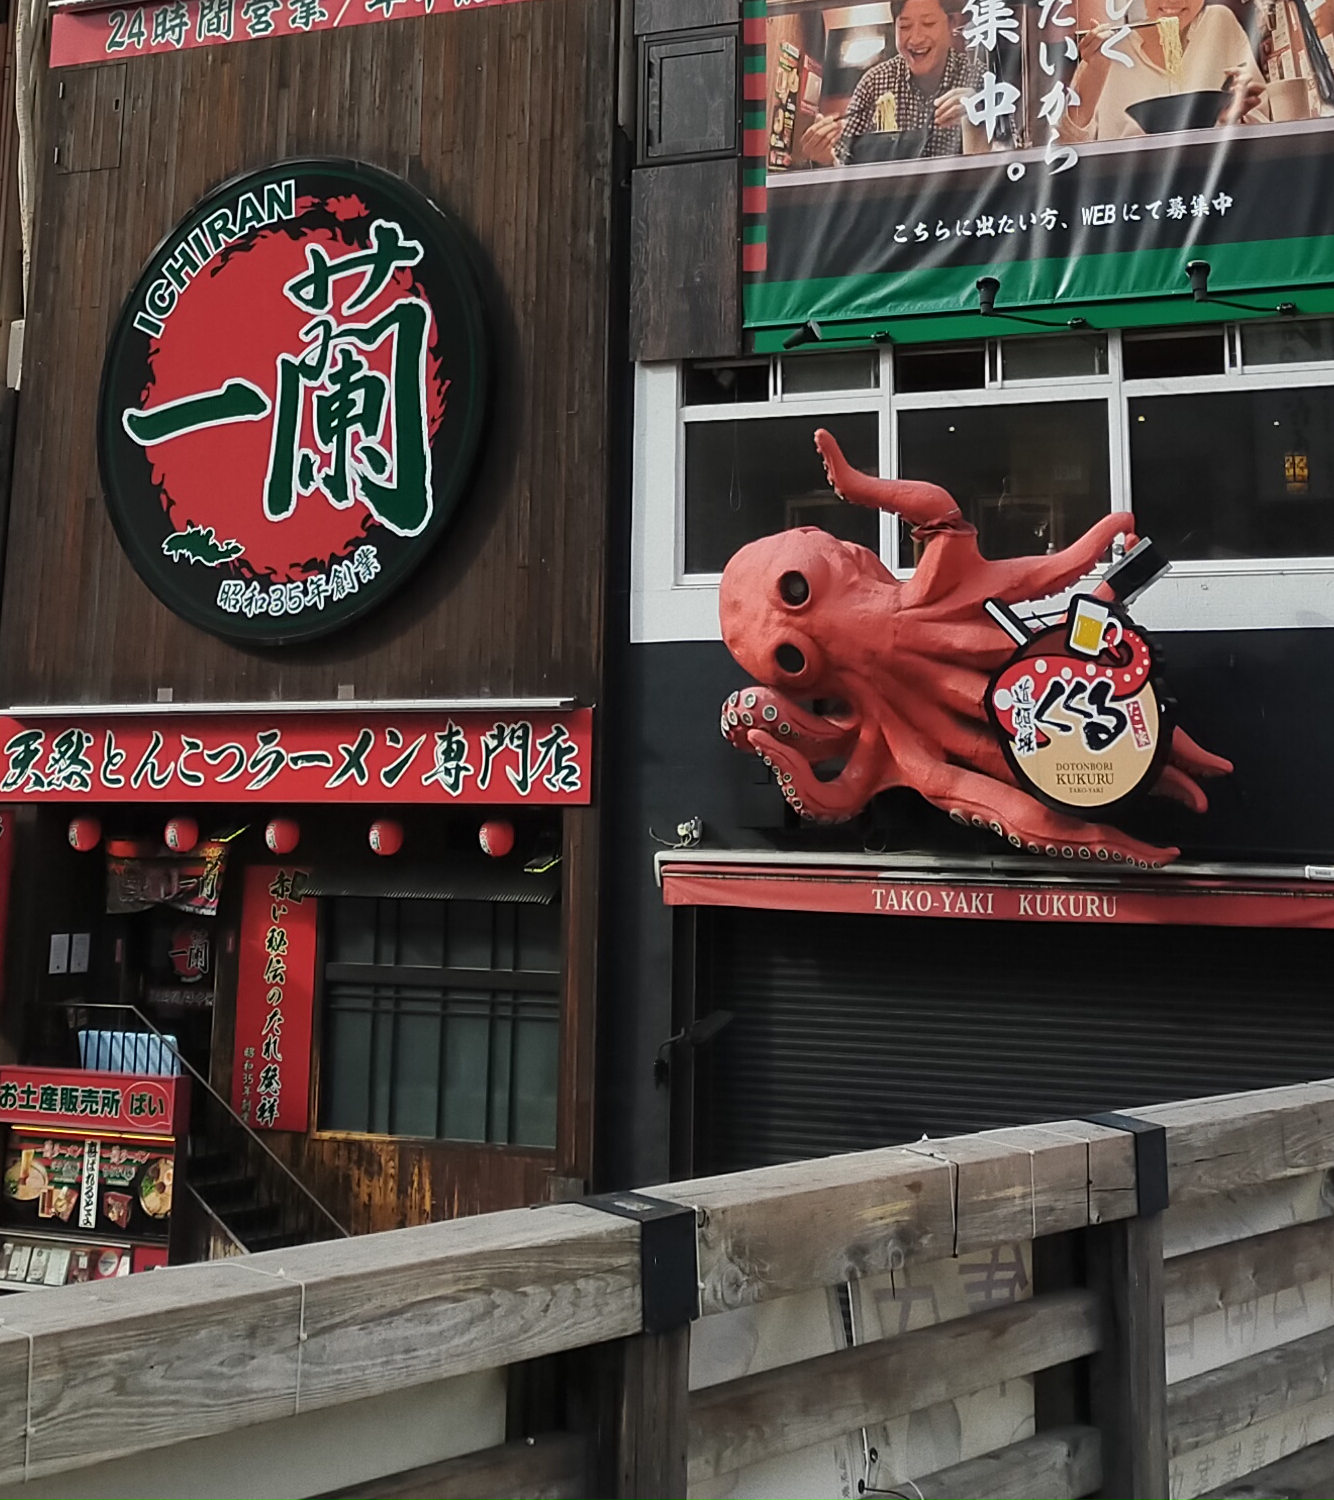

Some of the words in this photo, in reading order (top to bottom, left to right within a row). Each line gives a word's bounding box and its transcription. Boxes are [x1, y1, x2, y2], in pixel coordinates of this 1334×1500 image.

[133, 180, 297, 338] ICHIRAN
[121, 218, 434, 538] 一蘭
[216, 546, 382, 618] 昭和35年創業
[0, 718, 582, 797] 天然とんこつラーメン専門店
[1055, 762, 1114, 772] DOTONBORI
[1056, 773, 1115, 786] KUKURU
[870, 887, 995, 916] TAKO-YAKI
[1017, 891, 1118, 919] KUKURU
[129, 1092, 165, 1117] ばい
